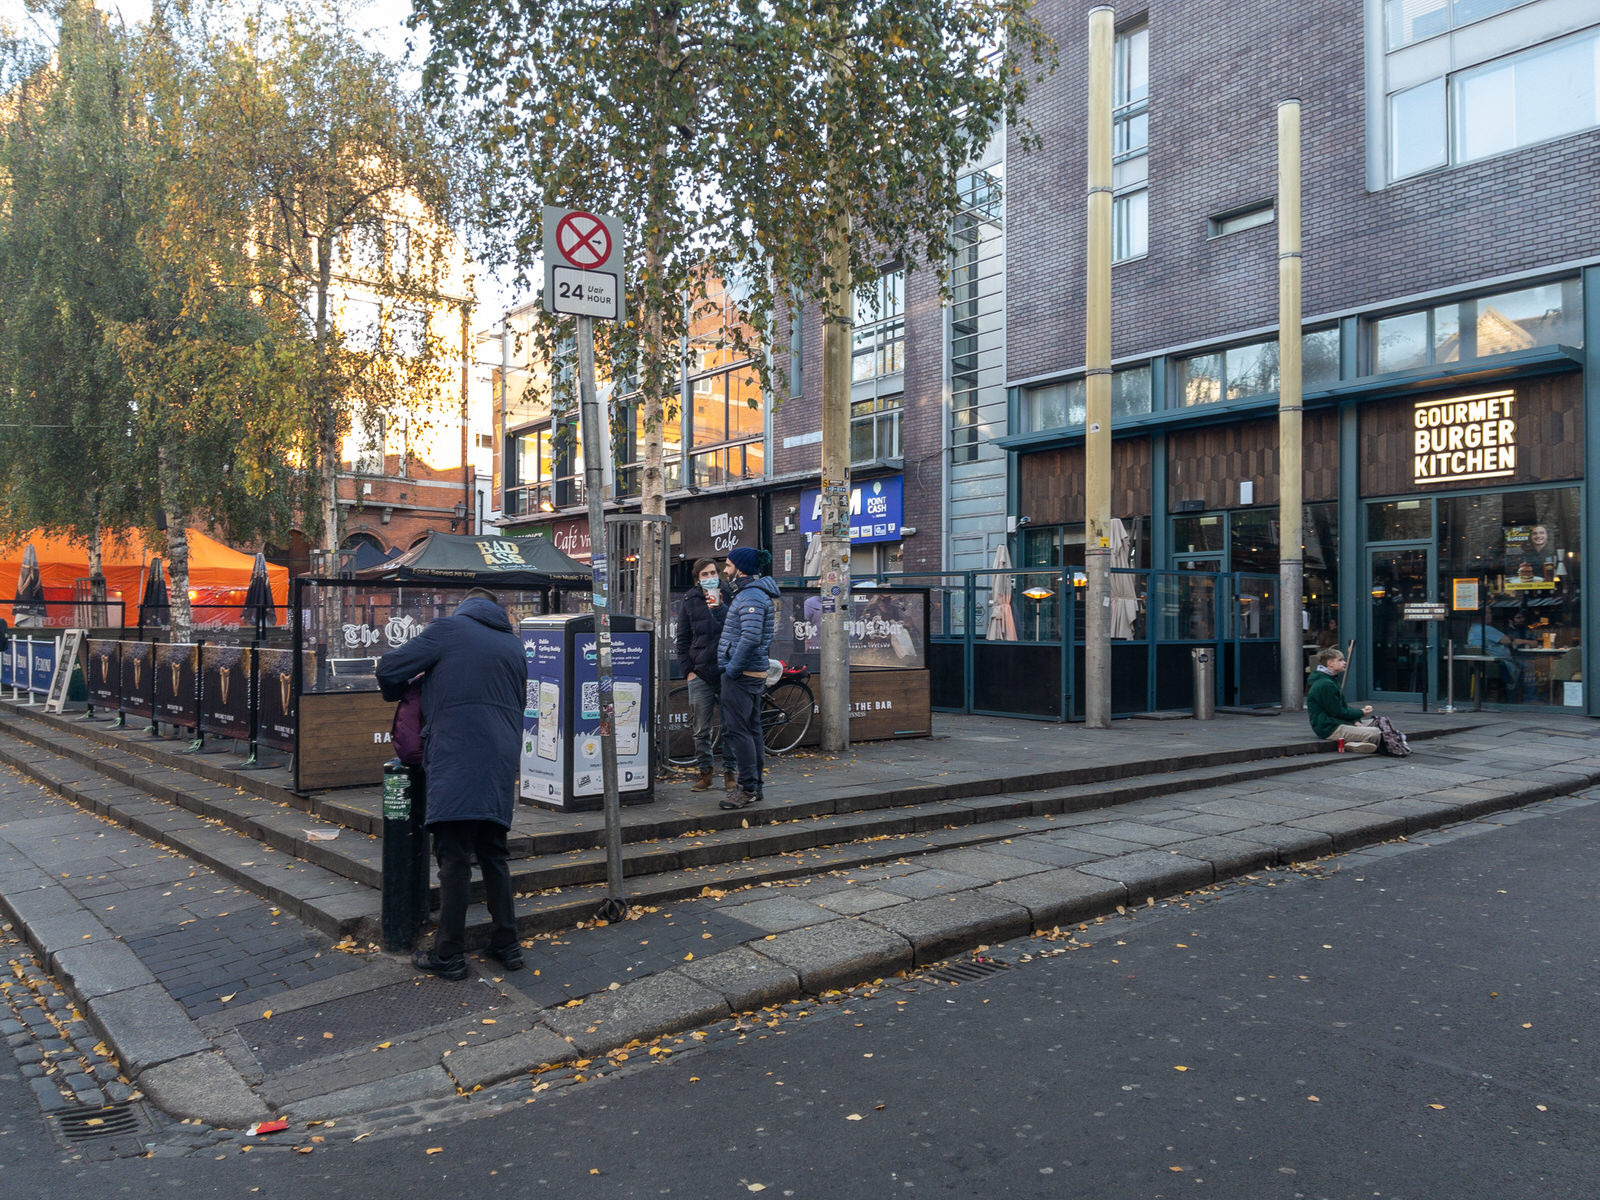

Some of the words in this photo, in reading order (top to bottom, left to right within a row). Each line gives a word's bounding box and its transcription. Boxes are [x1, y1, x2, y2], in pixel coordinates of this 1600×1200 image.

[559, 282, 584, 300] 24
[587, 286, 604, 294] Uair
[587, 295, 611, 304] HOUR
[1414, 397, 1515, 428] GOURMET
[1414, 419, 1516, 454] BURGER
[1414, 445, 1516, 477] KITCHEN
[867, 496, 887, 506] POINT
[867, 504, 887, 514] CASH
[711, 515, 744, 533] BADASS
[475, 540, 519, 554] BAD
[553, 524, 578, 554] Café
[714, 531, 739, 551] Cafe
[483, 552, 527, 565] ASS
[412, 567, 430, 575] Food
[342, 623, 380, 648] The
[793, 620, 818, 640] The
[855, 702, 872, 711] THE
[875, 700, 893, 710] BAR
[668, 713, 688, 723] THE
